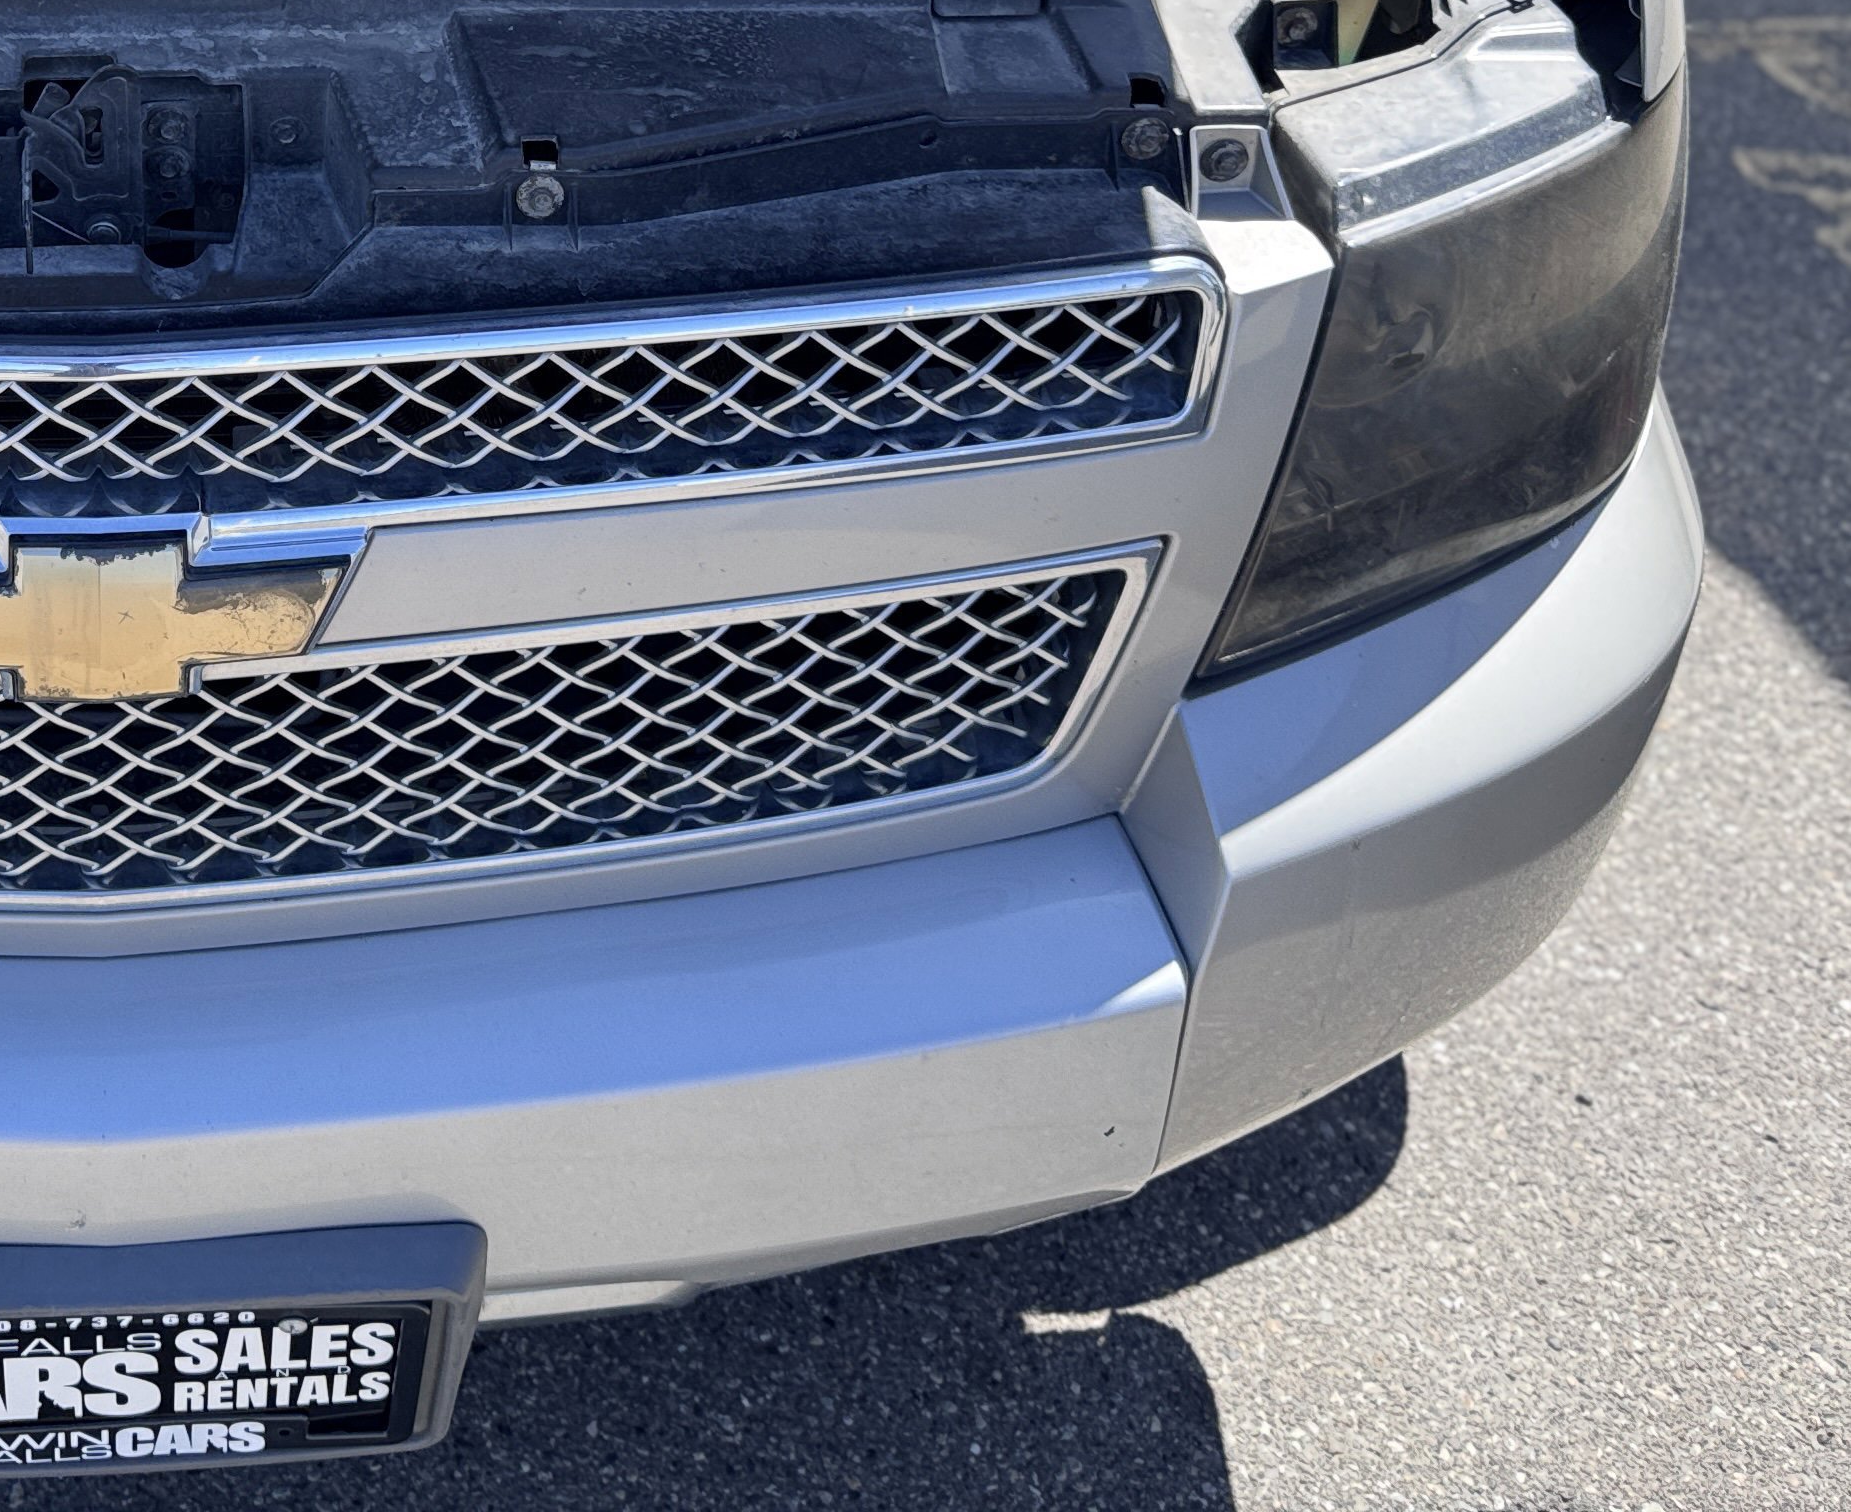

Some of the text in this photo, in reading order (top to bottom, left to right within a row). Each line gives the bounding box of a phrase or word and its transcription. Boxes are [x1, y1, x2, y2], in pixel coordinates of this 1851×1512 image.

[174, 1322, 396, 1375] SALES
[173, 1371, 392, 1413] RENTALS
[115, 1421, 266, 1458] CARS
